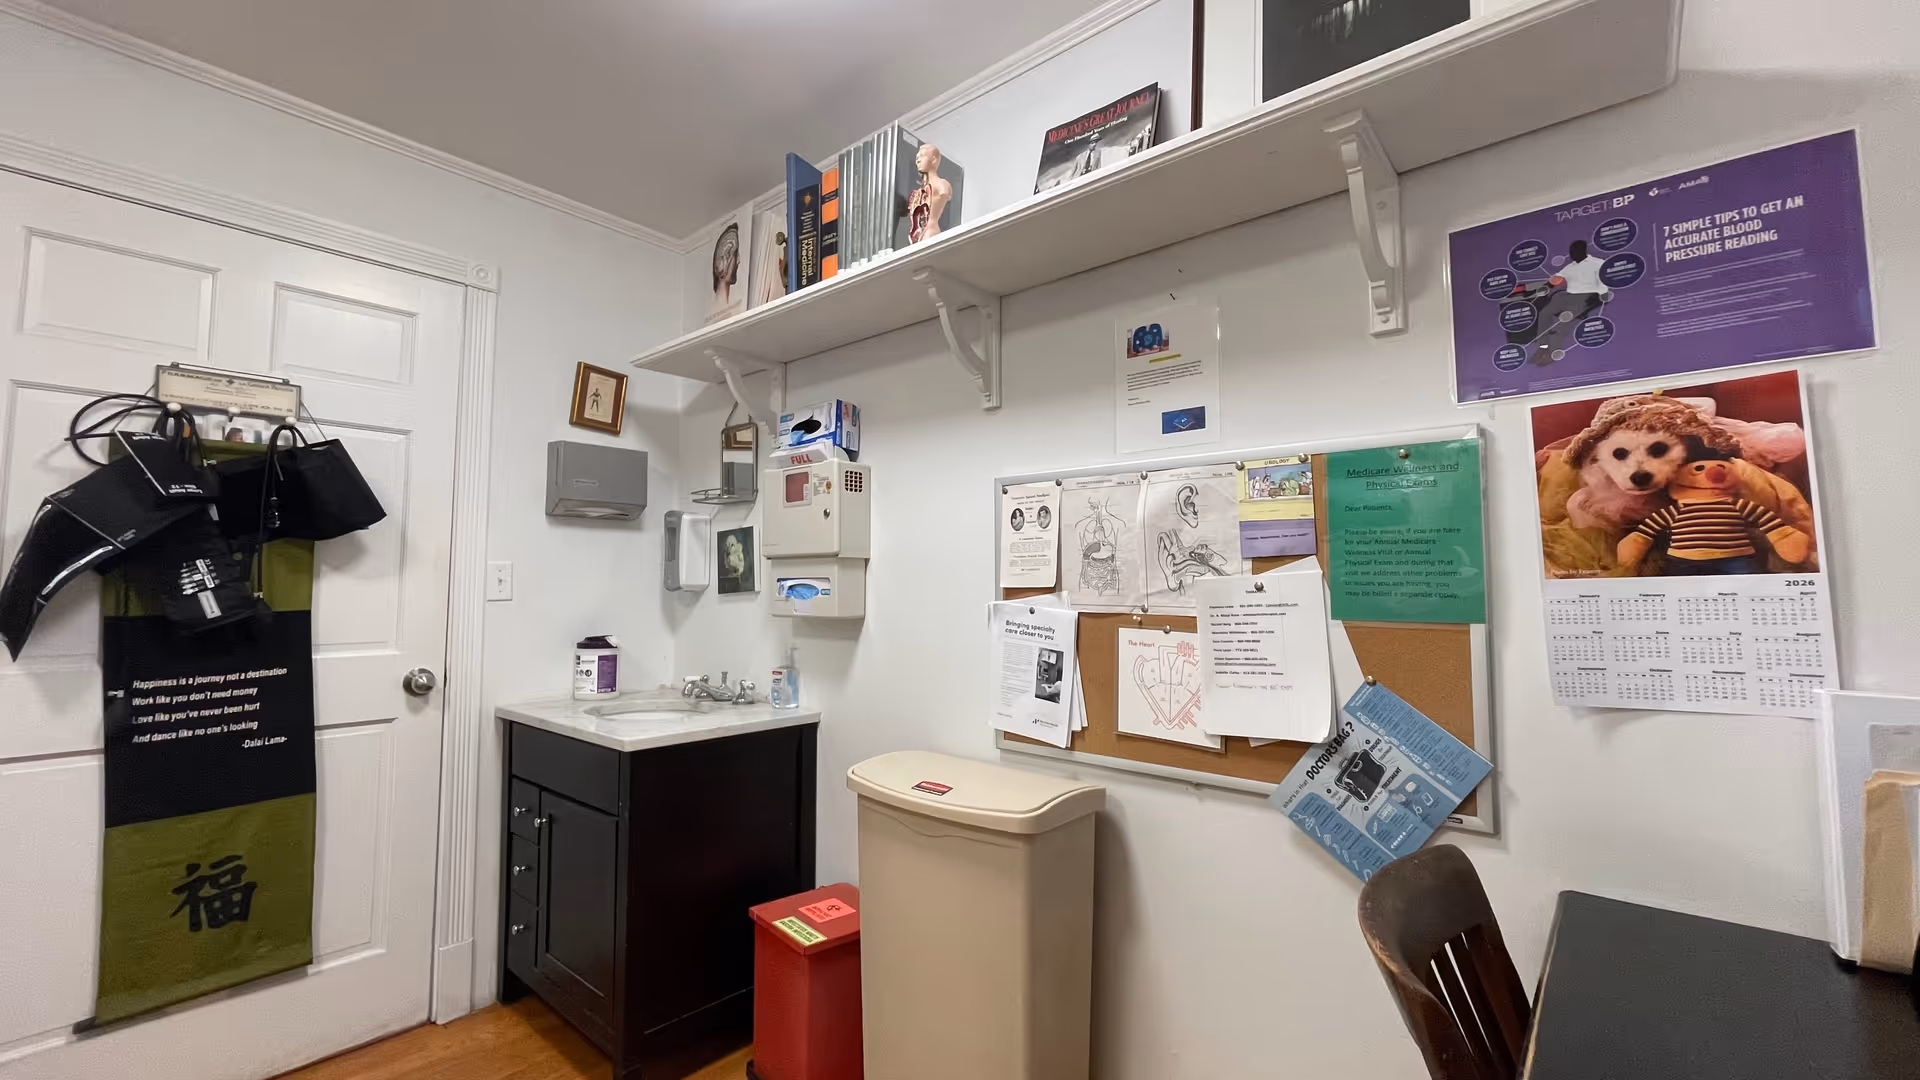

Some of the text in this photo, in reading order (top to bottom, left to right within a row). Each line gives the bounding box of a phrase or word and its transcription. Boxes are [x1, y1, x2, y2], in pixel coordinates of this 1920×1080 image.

[1089, 108, 1115, 126] GREAT
[1663, 195, 1803, 236] 7 SIMPLE TIPS TO GET AN
[1664, 218, 1762, 250] ACCURATE BLOOD
[1665, 229, 1778, 263] PRESSURE READING
[790, 453, 812, 464] FULL
[1346, 467, 1390, 477] Medicare
[1440, 463, 1459, 471] and
[1005, 619, 1055, 634] Bringing specialty
[133, 678, 177, 689] Happiness
[179, 676, 186, 685] is
[193, 673, 226, 686] journey
[226, 672, 240, 681] not
[246, 667, 287, 679] destination
[132, 686, 258, 706] Work like you don't need money
[132, 702, 260, 724] Love like you've never been hurt
[132, 720, 258, 743] And dance like no one's looking
[241, 736, 288, 749] -Dalai Lama-
[1305, 743, 1338, 780] DOCTOR'S
[169, 854, 257, 932] 福
